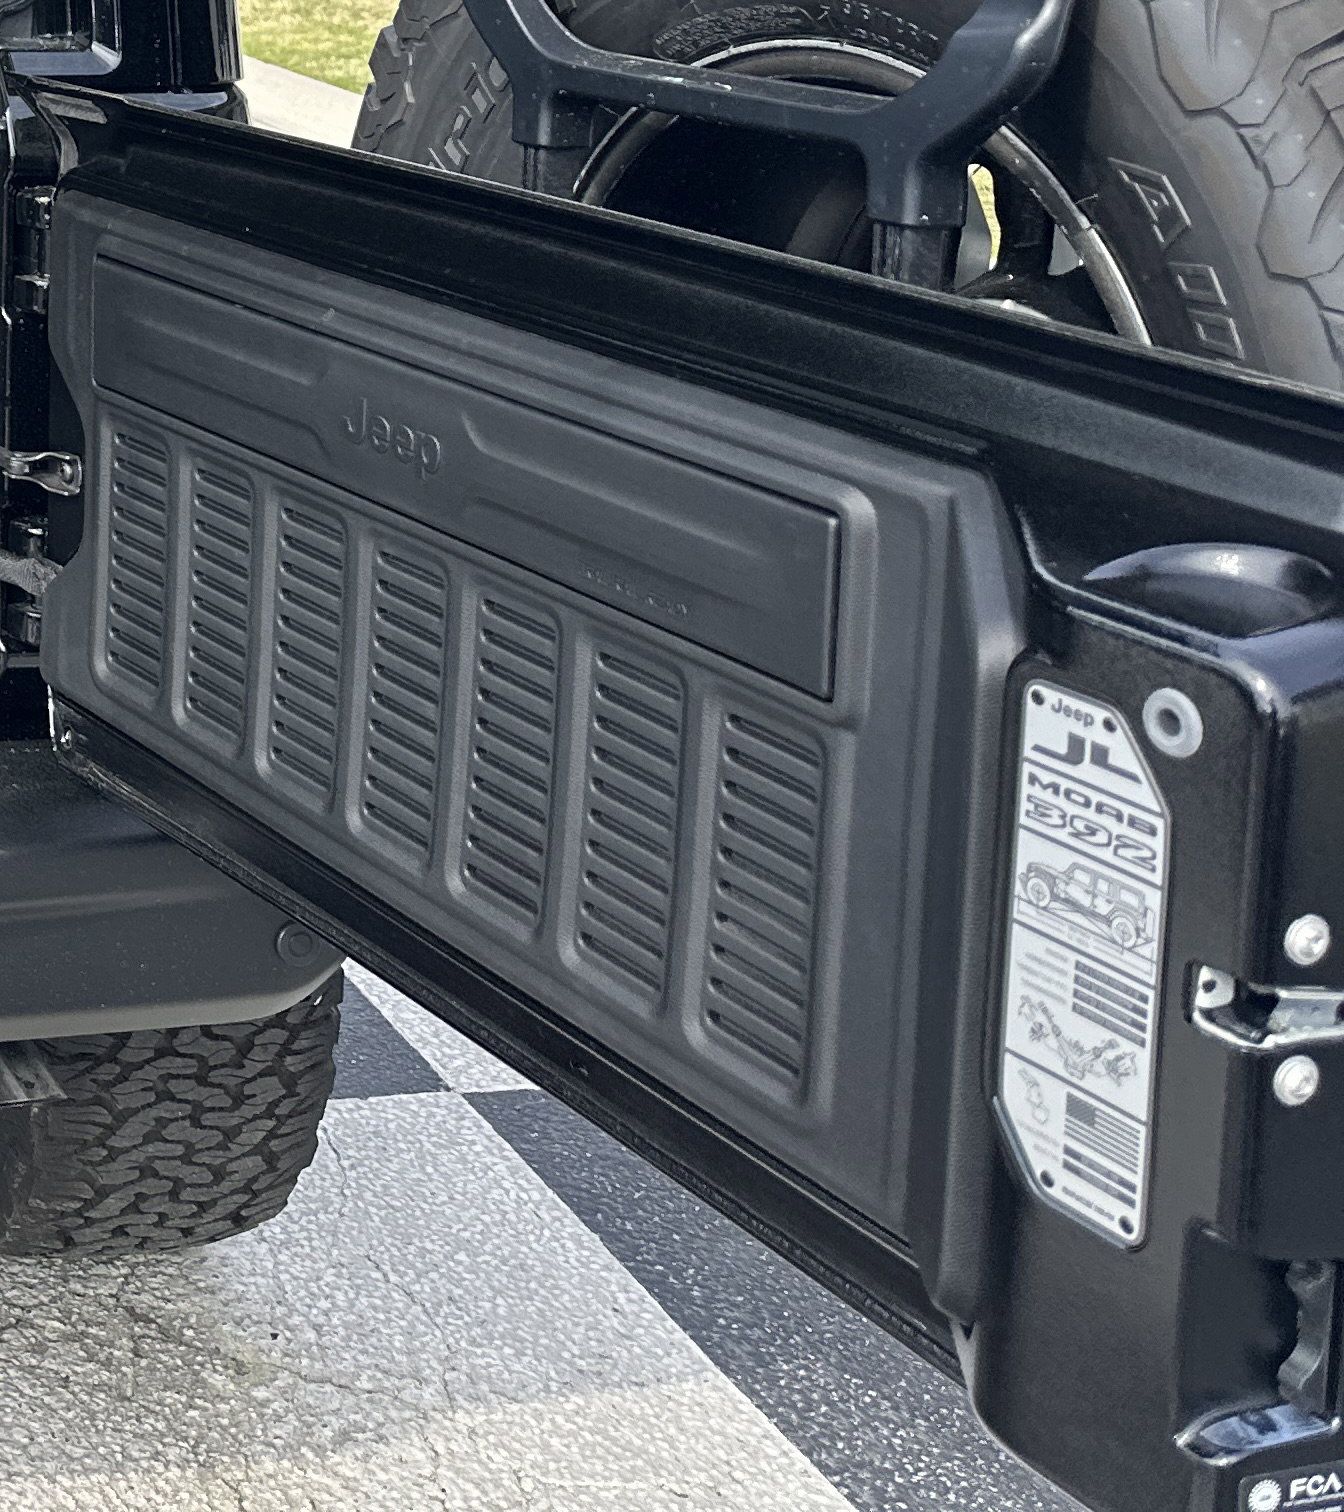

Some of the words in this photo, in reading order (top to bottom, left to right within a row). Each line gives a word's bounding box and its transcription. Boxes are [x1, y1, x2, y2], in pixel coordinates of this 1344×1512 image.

[340, 396, 442, 481] Jeep
[1051, 698, 1095, 728] Jeep
[1030, 731, 1143, 785] JL
[1025, 792, 1157, 874] 392
[1027, 771, 1158, 838] MOAB
